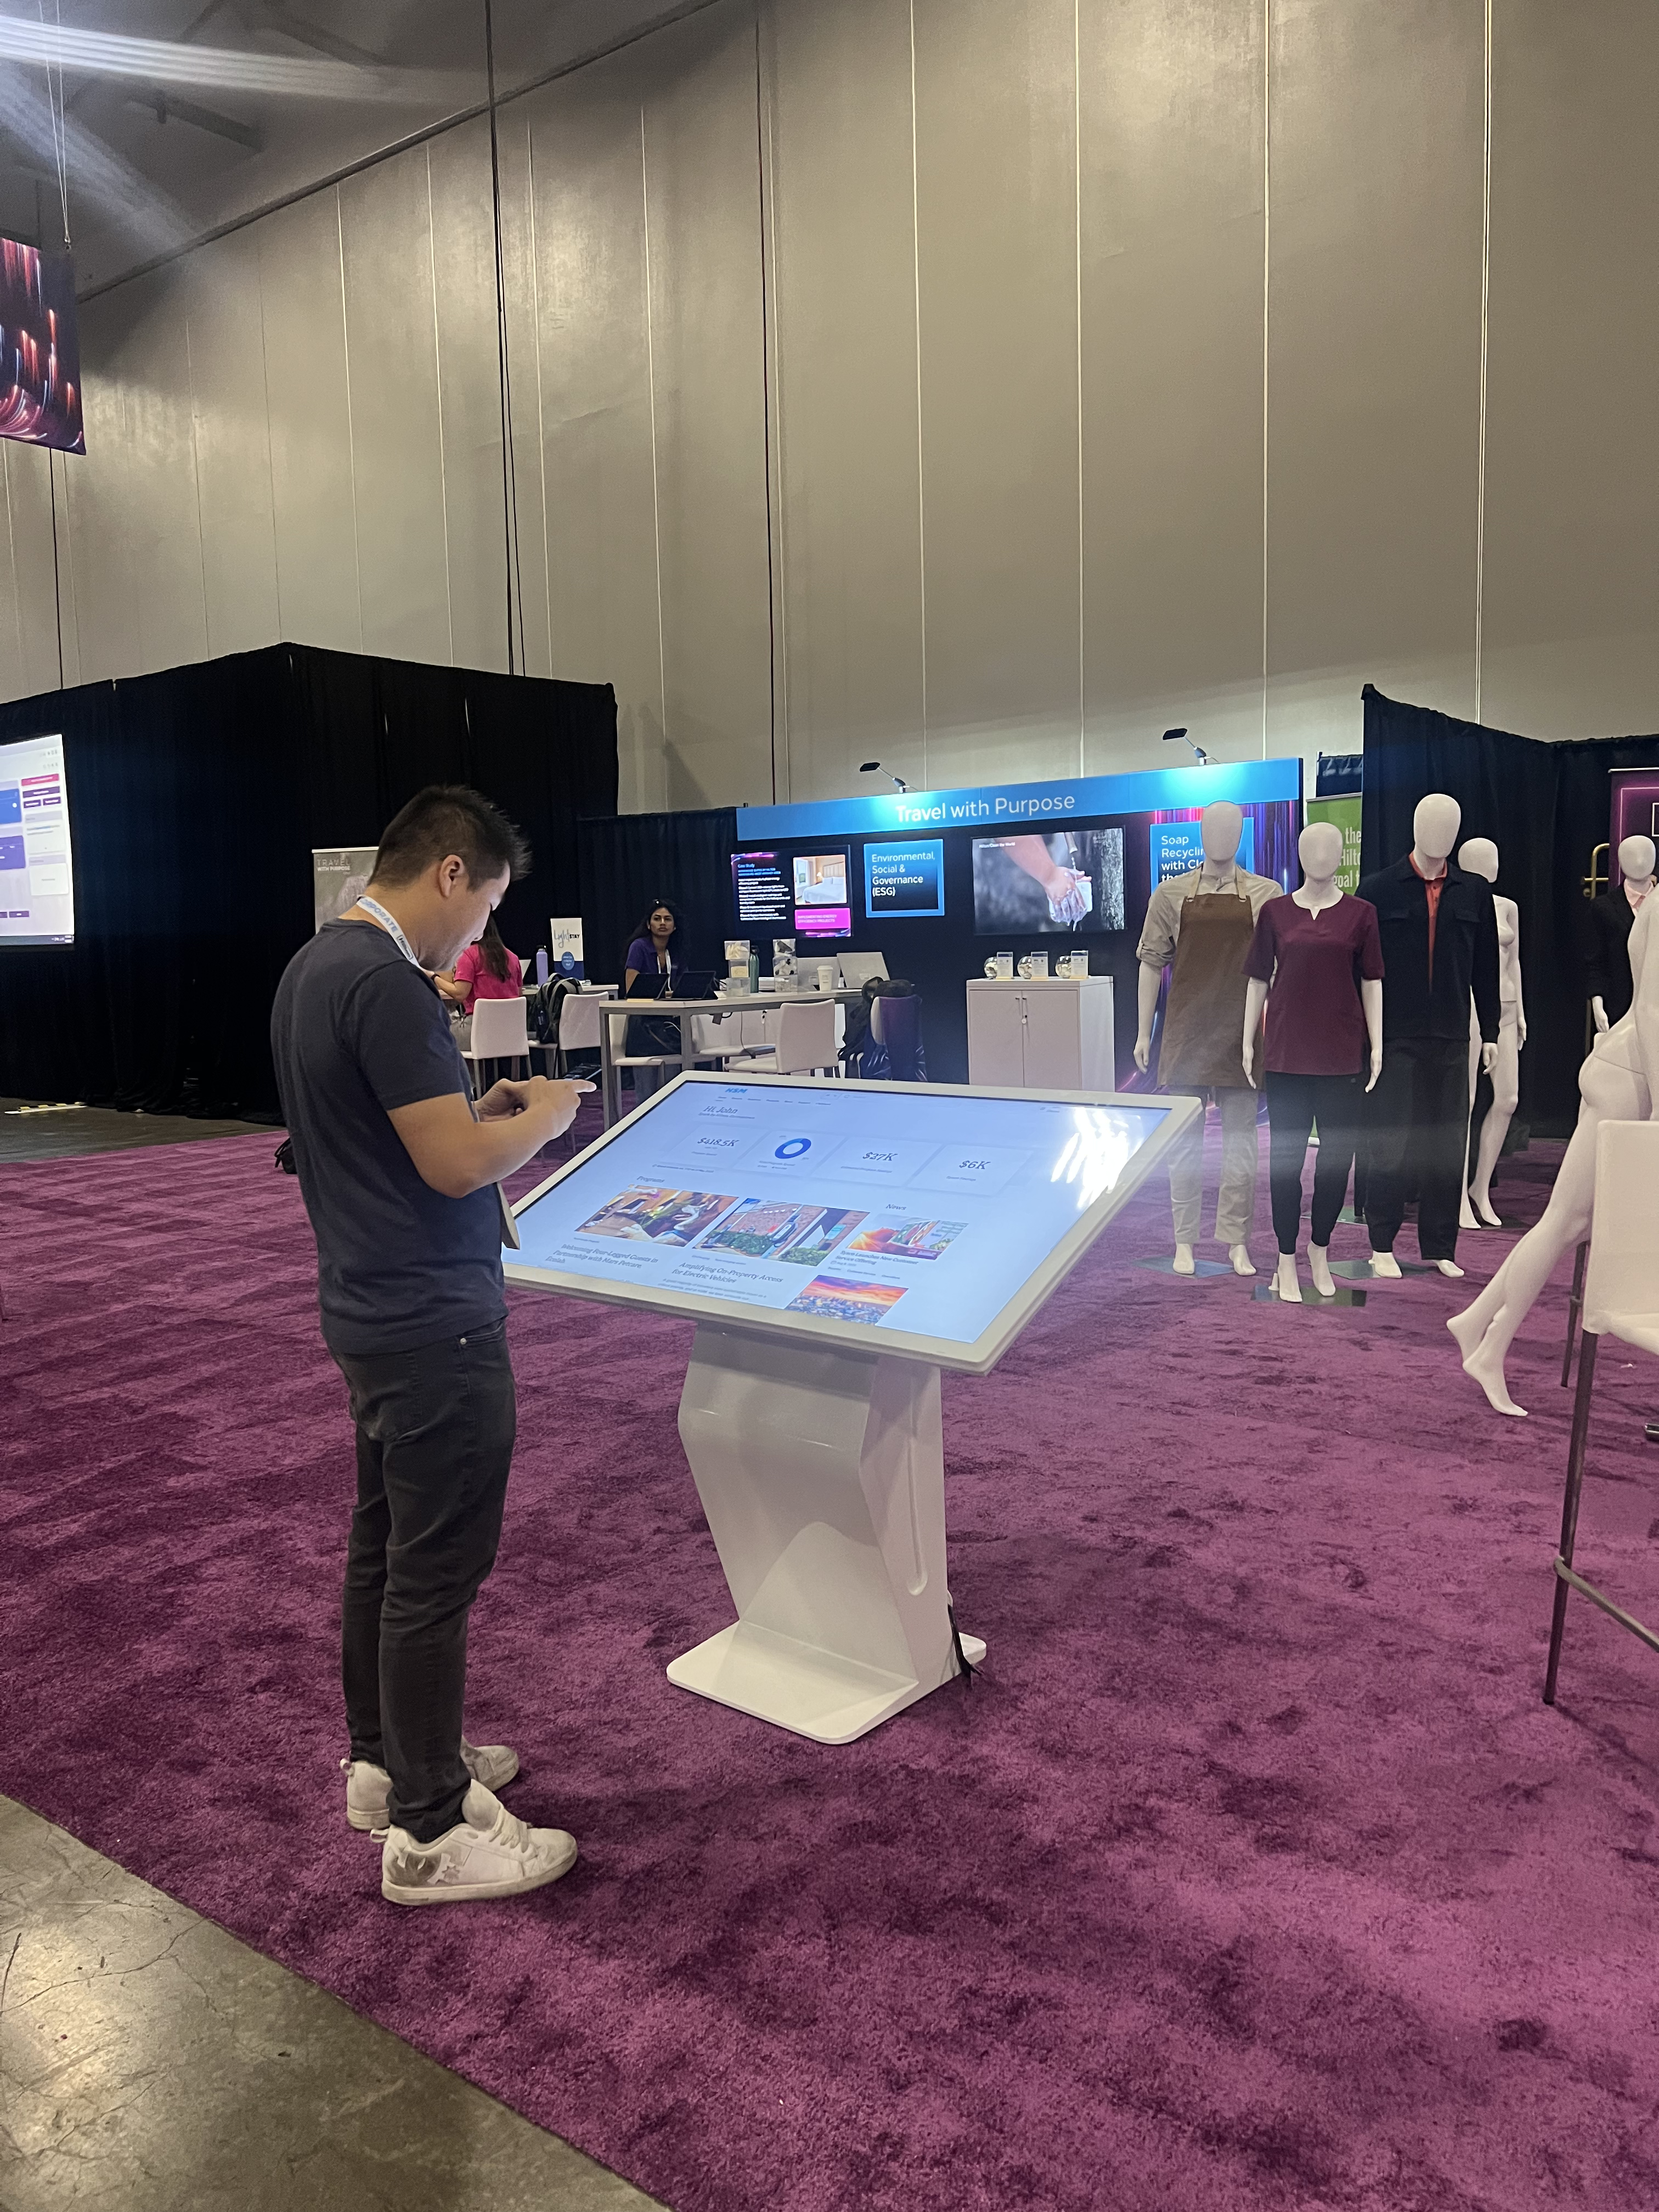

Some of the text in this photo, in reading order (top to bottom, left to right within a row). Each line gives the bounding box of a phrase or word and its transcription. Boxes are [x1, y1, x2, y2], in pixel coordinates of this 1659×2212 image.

[896, 795, 1075, 822] Travel with Purpose
[1345, 826, 1361, 844] the
[1161, 836, 1189, 845] Soap
[872, 851, 935, 862] Environmental,
[872, 864, 905, 874] Social &
[1161, 860, 1185, 870] with
[872, 876, 923, 885] Governance
[872, 887, 896, 897] (ESG)
[697, 1138, 740, 1147] $418.5K
[959, 1160, 991, 1170] $6K
[553, 1250, 588, 1261] Partnership
[679, 1262, 783, 1283] Amplifying On-Property Access
[683, 1270, 709, 1279] Electric
[709, 1274, 737, 1283] Vehicles
